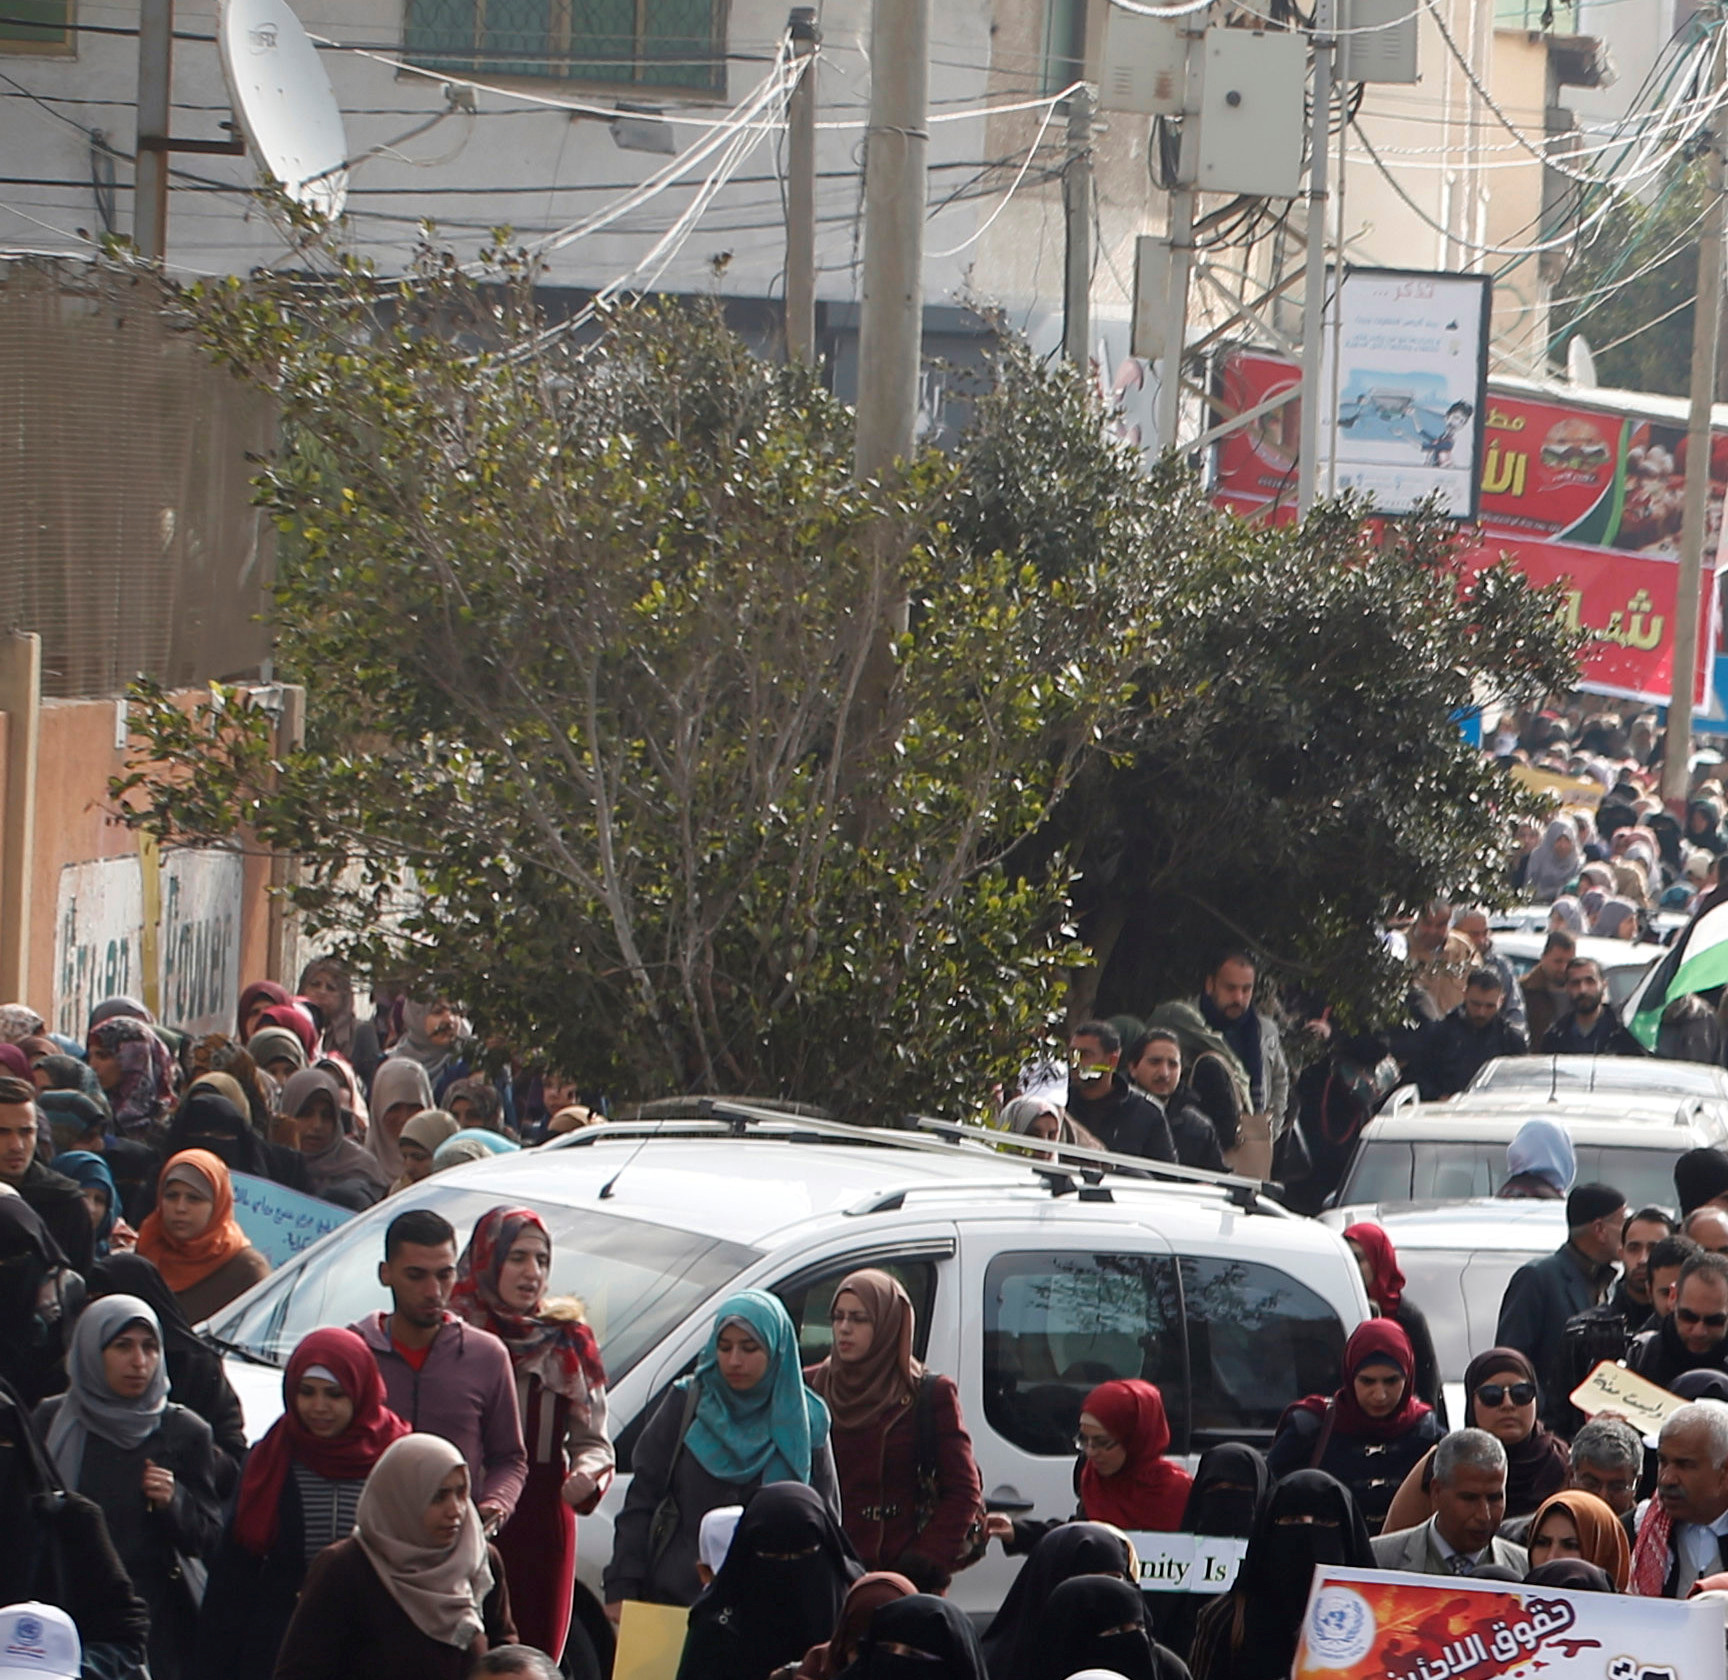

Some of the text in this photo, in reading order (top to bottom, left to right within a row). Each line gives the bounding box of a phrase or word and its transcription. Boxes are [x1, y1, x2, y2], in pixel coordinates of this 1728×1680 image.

[1140, 1553, 1191, 1585] nity
[1203, 1557, 1227, 1581] Is
[1490, 1599, 1573, 1660] حقوق
